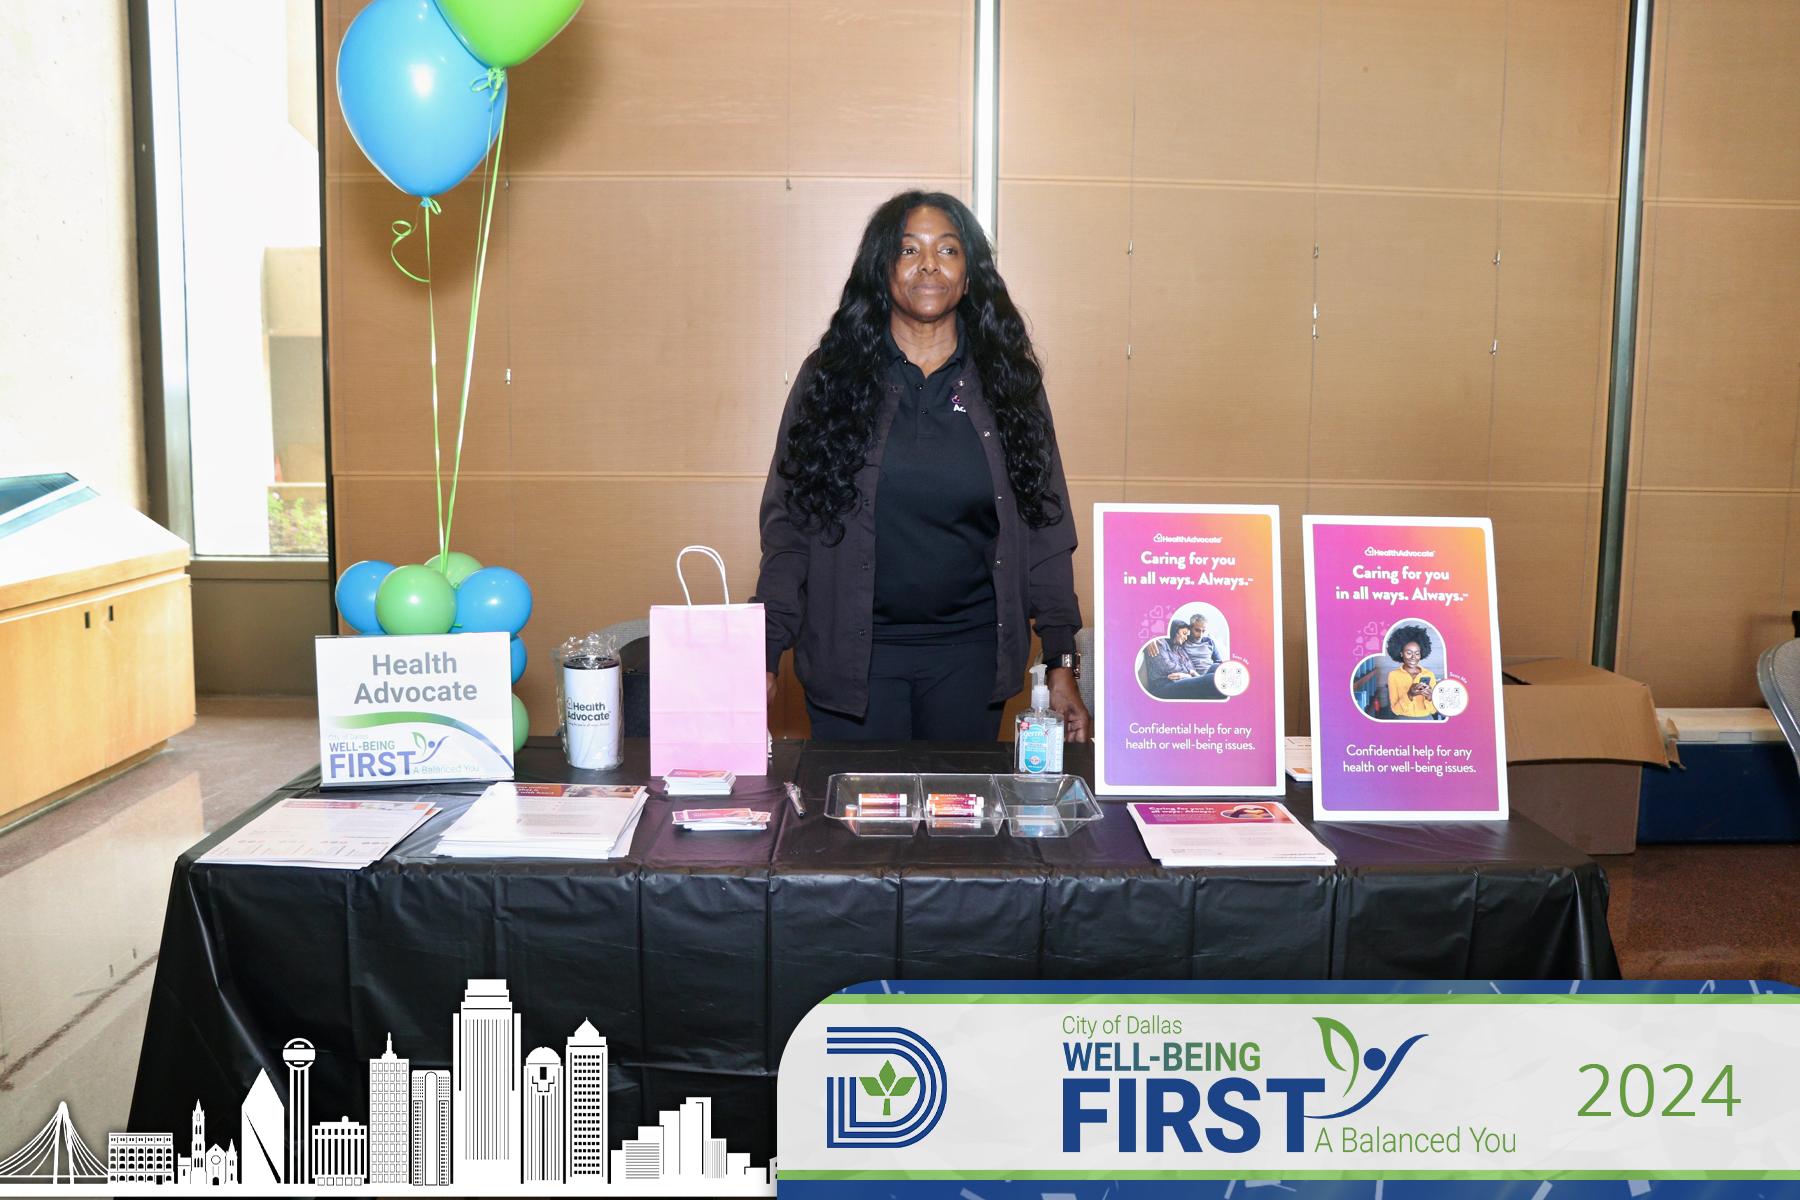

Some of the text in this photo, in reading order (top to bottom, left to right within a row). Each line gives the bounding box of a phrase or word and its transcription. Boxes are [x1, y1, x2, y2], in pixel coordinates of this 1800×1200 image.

[1140, 551, 1236, 570] Caring for you
[1123, 571, 1137, 585] in
[1140, 571, 1156, 585] all
[1159, 575, 1195, 590] ways.
[1352, 564, 1450, 585] Caring for you
[1335, 586, 1349, 600] in
[1353, 586, 1369, 600] all
[1372, 589, 1409, 605] ways.
[372, 651, 457, 676] Health
[353, 680, 478, 705] Advocate
[573, 702, 605, 711] Health
[567, 711, 610, 722] Advocate
[1129, 722, 1252, 738] Confidential help for any
[329, 740, 395, 752] WELL-BEING
[1125, 738, 1256, 753] health or well-being issues.
[1346, 744, 1472, 761] Confidential help for any
[329, 751, 416, 779] FIRST
[413, 763, 480, 775] A Balanced You
[1343, 761, 1477, 777] health or well-being issues.
